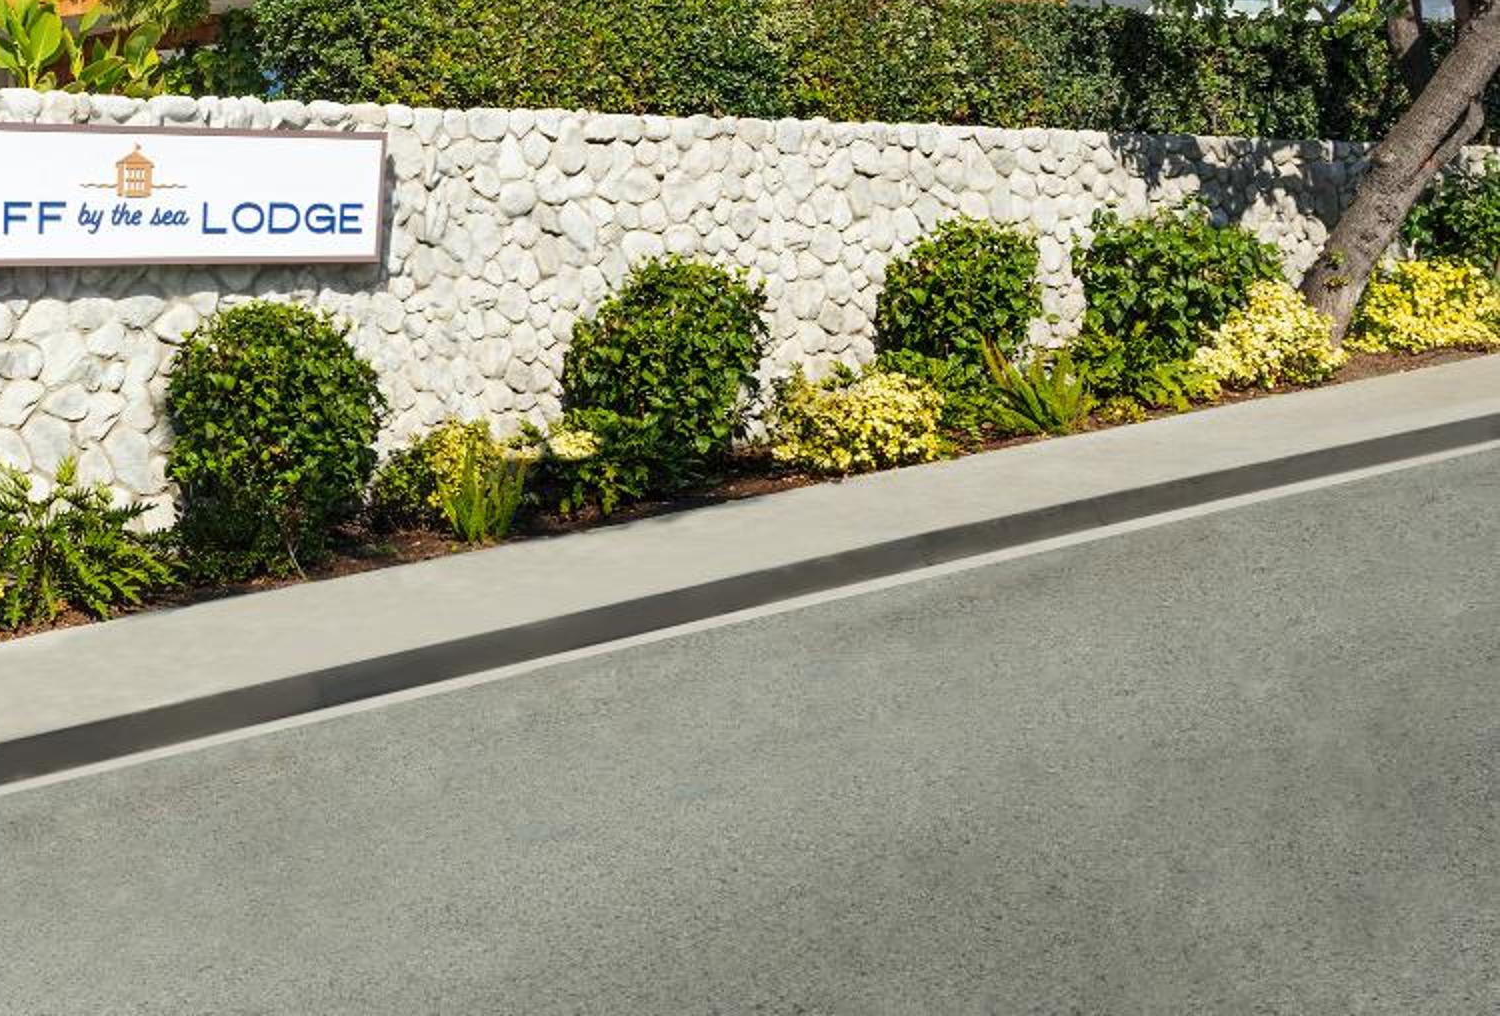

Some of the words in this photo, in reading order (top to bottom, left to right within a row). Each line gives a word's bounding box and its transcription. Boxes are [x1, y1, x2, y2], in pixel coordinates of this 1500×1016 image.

[77, 201, 104, 234] by
[111, 201, 143, 226] the
[149, 206, 190, 226] sea
[202, 201, 364, 234] LODGE
